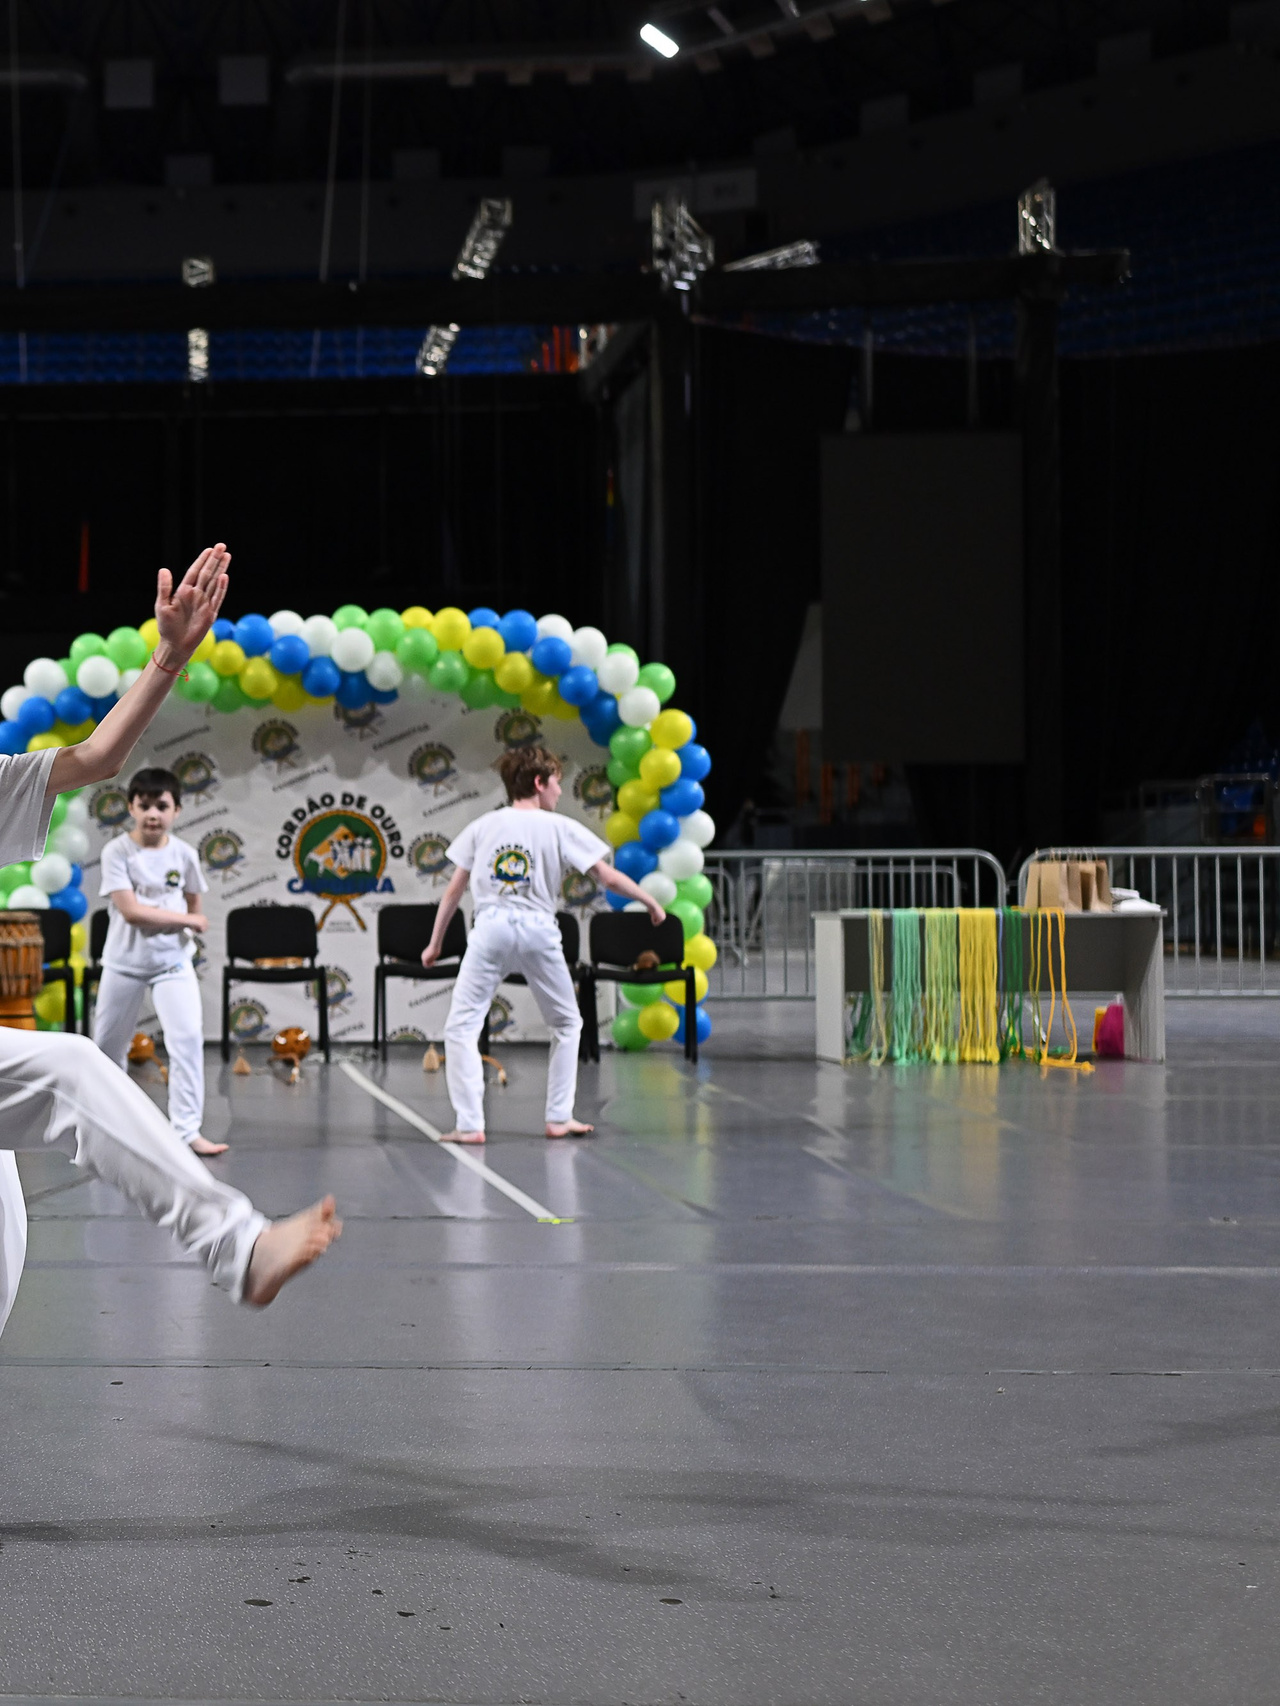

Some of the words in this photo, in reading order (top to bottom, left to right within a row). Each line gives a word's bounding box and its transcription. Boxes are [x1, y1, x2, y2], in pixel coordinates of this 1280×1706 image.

[276, 792, 335, 860] CORDÃO
[341, 792, 367, 809] DE
[370, 804, 405, 858] OURO
